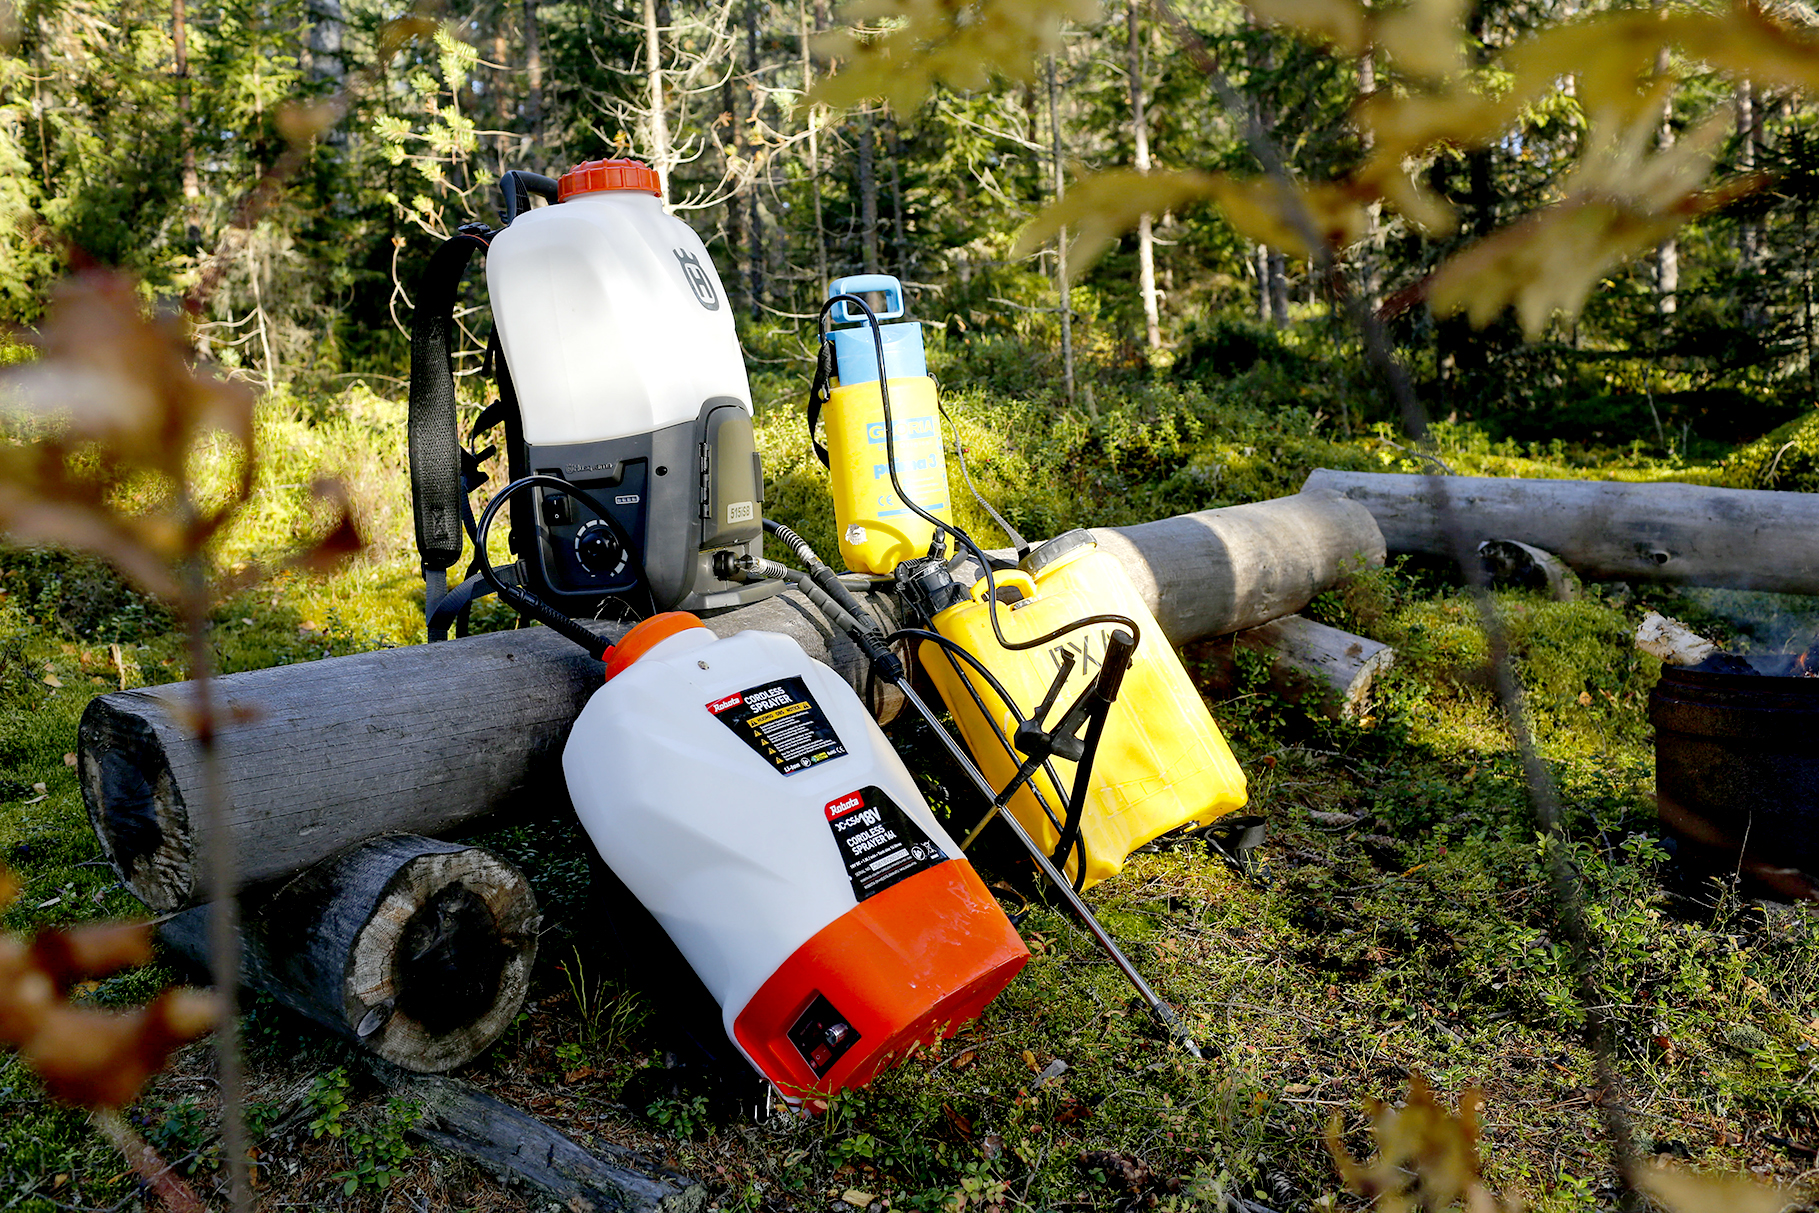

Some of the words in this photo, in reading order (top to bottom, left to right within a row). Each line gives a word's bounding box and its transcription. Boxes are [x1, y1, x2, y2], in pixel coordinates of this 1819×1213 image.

[868, 419, 933, 439] GORIA
[928, 453, 937, 468] 3
[714, 697, 740, 712] Robota
[744, 687, 785, 705] CORDLESS
[750, 694, 793, 714] SPRAYER
[829, 798, 859, 816] Robota
[846, 824, 885, 847] CORDLESS
[852, 834, 887, 856] SPRAYER
